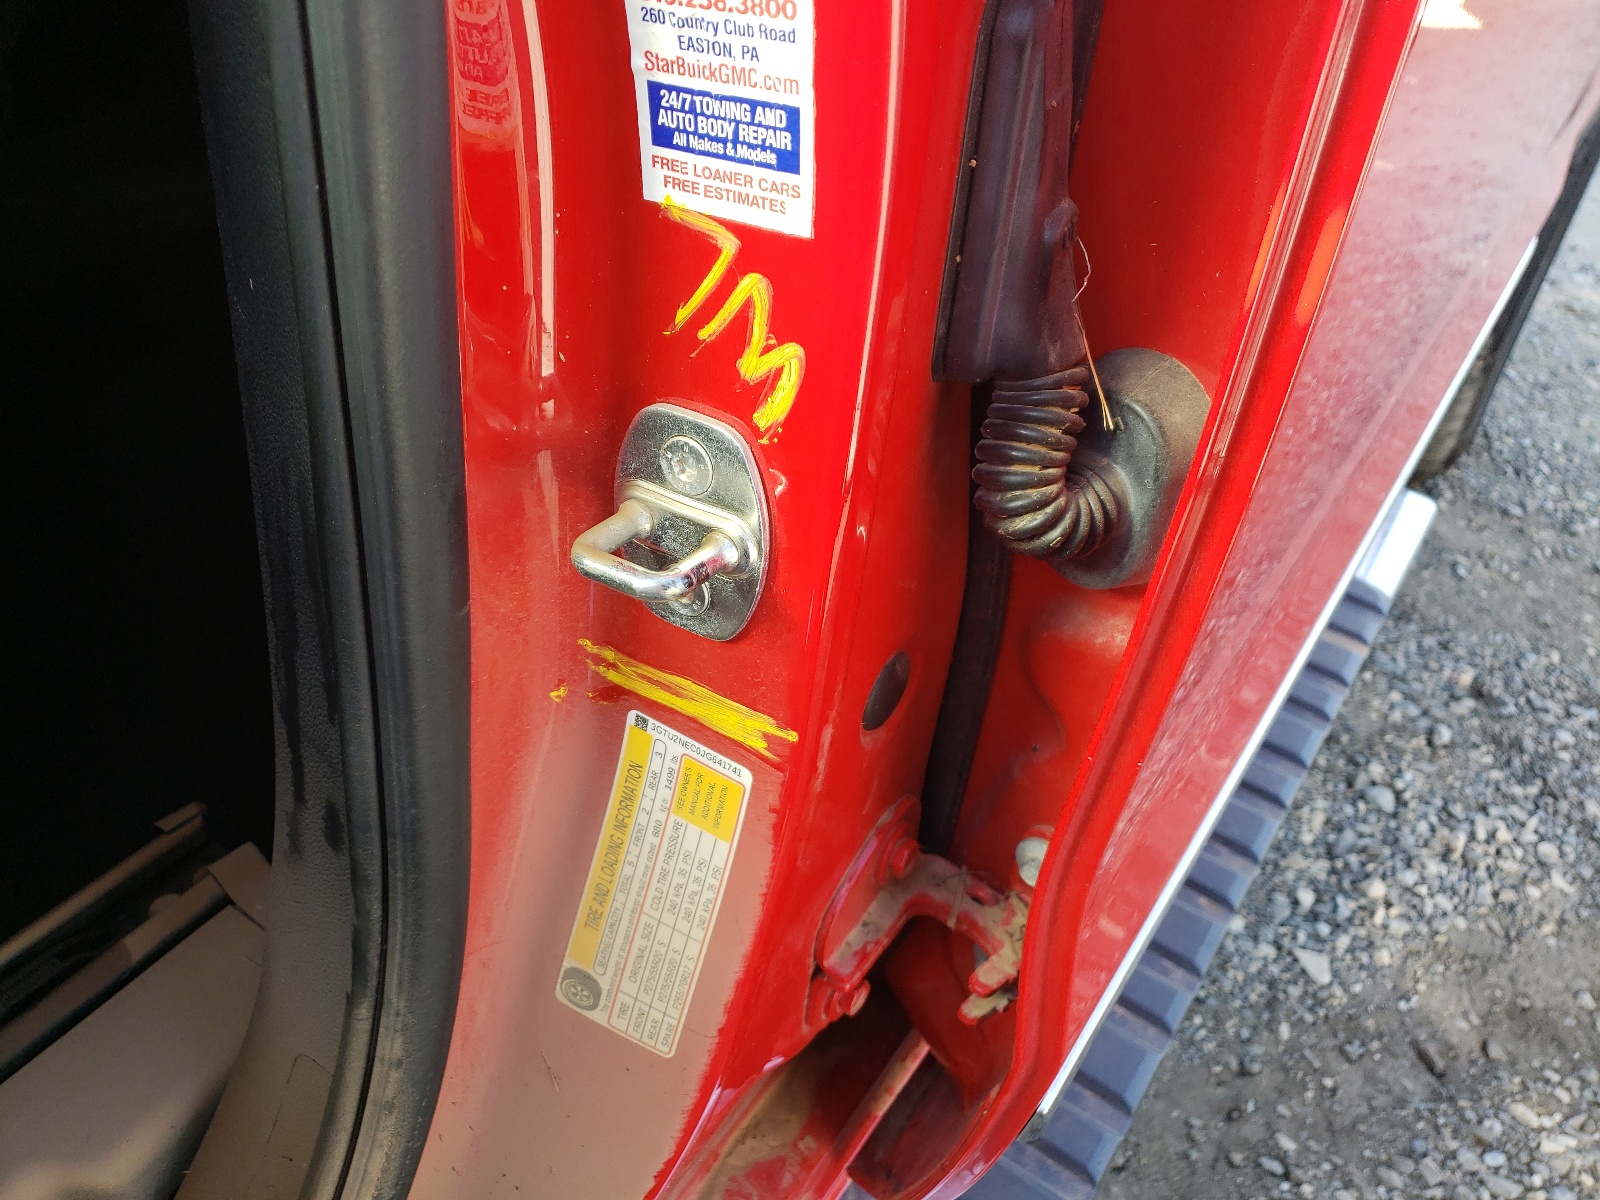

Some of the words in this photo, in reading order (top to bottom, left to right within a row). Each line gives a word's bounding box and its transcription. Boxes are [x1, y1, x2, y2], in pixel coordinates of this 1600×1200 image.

[641, 6, 666, 25] 260
[669, 12, 719, 37] Country
[724, 18, 754, 38] Club
[759, 23, 796, 43] Road
[677, 35, 736, 61] EASTON,
[741, 45, 760, 62] PA
[644, 50, 800, 95] StarBuickGMC.com
[659, 89, 692, 110] 24/7
[693, 94, 751, 123] TOWING
[754, 106, 787, 128] AND
[658, 108, 694, 132] AUTO
[697, 115, 735, 140] BODY
[739, 124, 792, 151] REPAIR
[672, 131, 687, 147] All
[689, 135, 724, 155] Makes
[725, 142, 735, 157] &
[736, 144, 777, 165] Models
[651, 154, 689, 175] FREE
[693, 163, 753, 189] LOANER
[758, 177, 801, 199] CARS
[663, 174, 701, 196] FREE
[703, 185, 786, 216] ESTIMATES
[651, 722, 742, 778] 3GTU2NEC0JG641741
[647, 769, 658, 790] REAR
[654, 750, 662, 758] 3
[678, 765, 693, 797] OWNER'S
[694, 772, 704, 787] FOR
[611, 759, 643, 835] INFORMATION
[651, 818, 663, 838] 680
[663, 766, 676, 791] 1499
[676, 796, 685, 810] SEE
[688, 787, 701, 815] MANUAL
[699, 780, 717, 820] ADDITIONAL
[710, 784, 730, 830] INFORMATION
[632, 821, 645, 847] FRONT
[641, 806, 649, 815] 2
[662, 818, 683, 866] PRESSURE
[598, 832, 624, 884] LOADING
[681, 848, 692, 865] PSI
[695, 856, 707, 873] PSI
[618, 871, 631, 895] TOTAL
[626, 859, 634, 867] 5
[656, 865, 670, 886] TIRE
[677, 866, 688, 879] 35
[692, 874, 702, 887] 35
[710, 864, 722, 880] PSI
[591, 881, 610, 908] AND
[649, 886, 664, 912] COLD
[706, 882, 716, 894] 35
[584, 905, 603, 932] TIRE
[666, 898, 679, 915] 240
[681, 906, 693, 923] 240
[695, 913, 707, 931] 240
[597, 938, 611, 969] SEATING
[605, 905, 621, 940] CAPACITY
[627, 941, 647, 984] ORIGINAL
[640, 920, 654, 942] SIZE
[617, 1000, 630, 1021] TIRE
[632, 1005, 646, 1033] FRONT
[646, 1017, 659, 1041] REAR
[660, 1020, 675, 1048] SPARE
